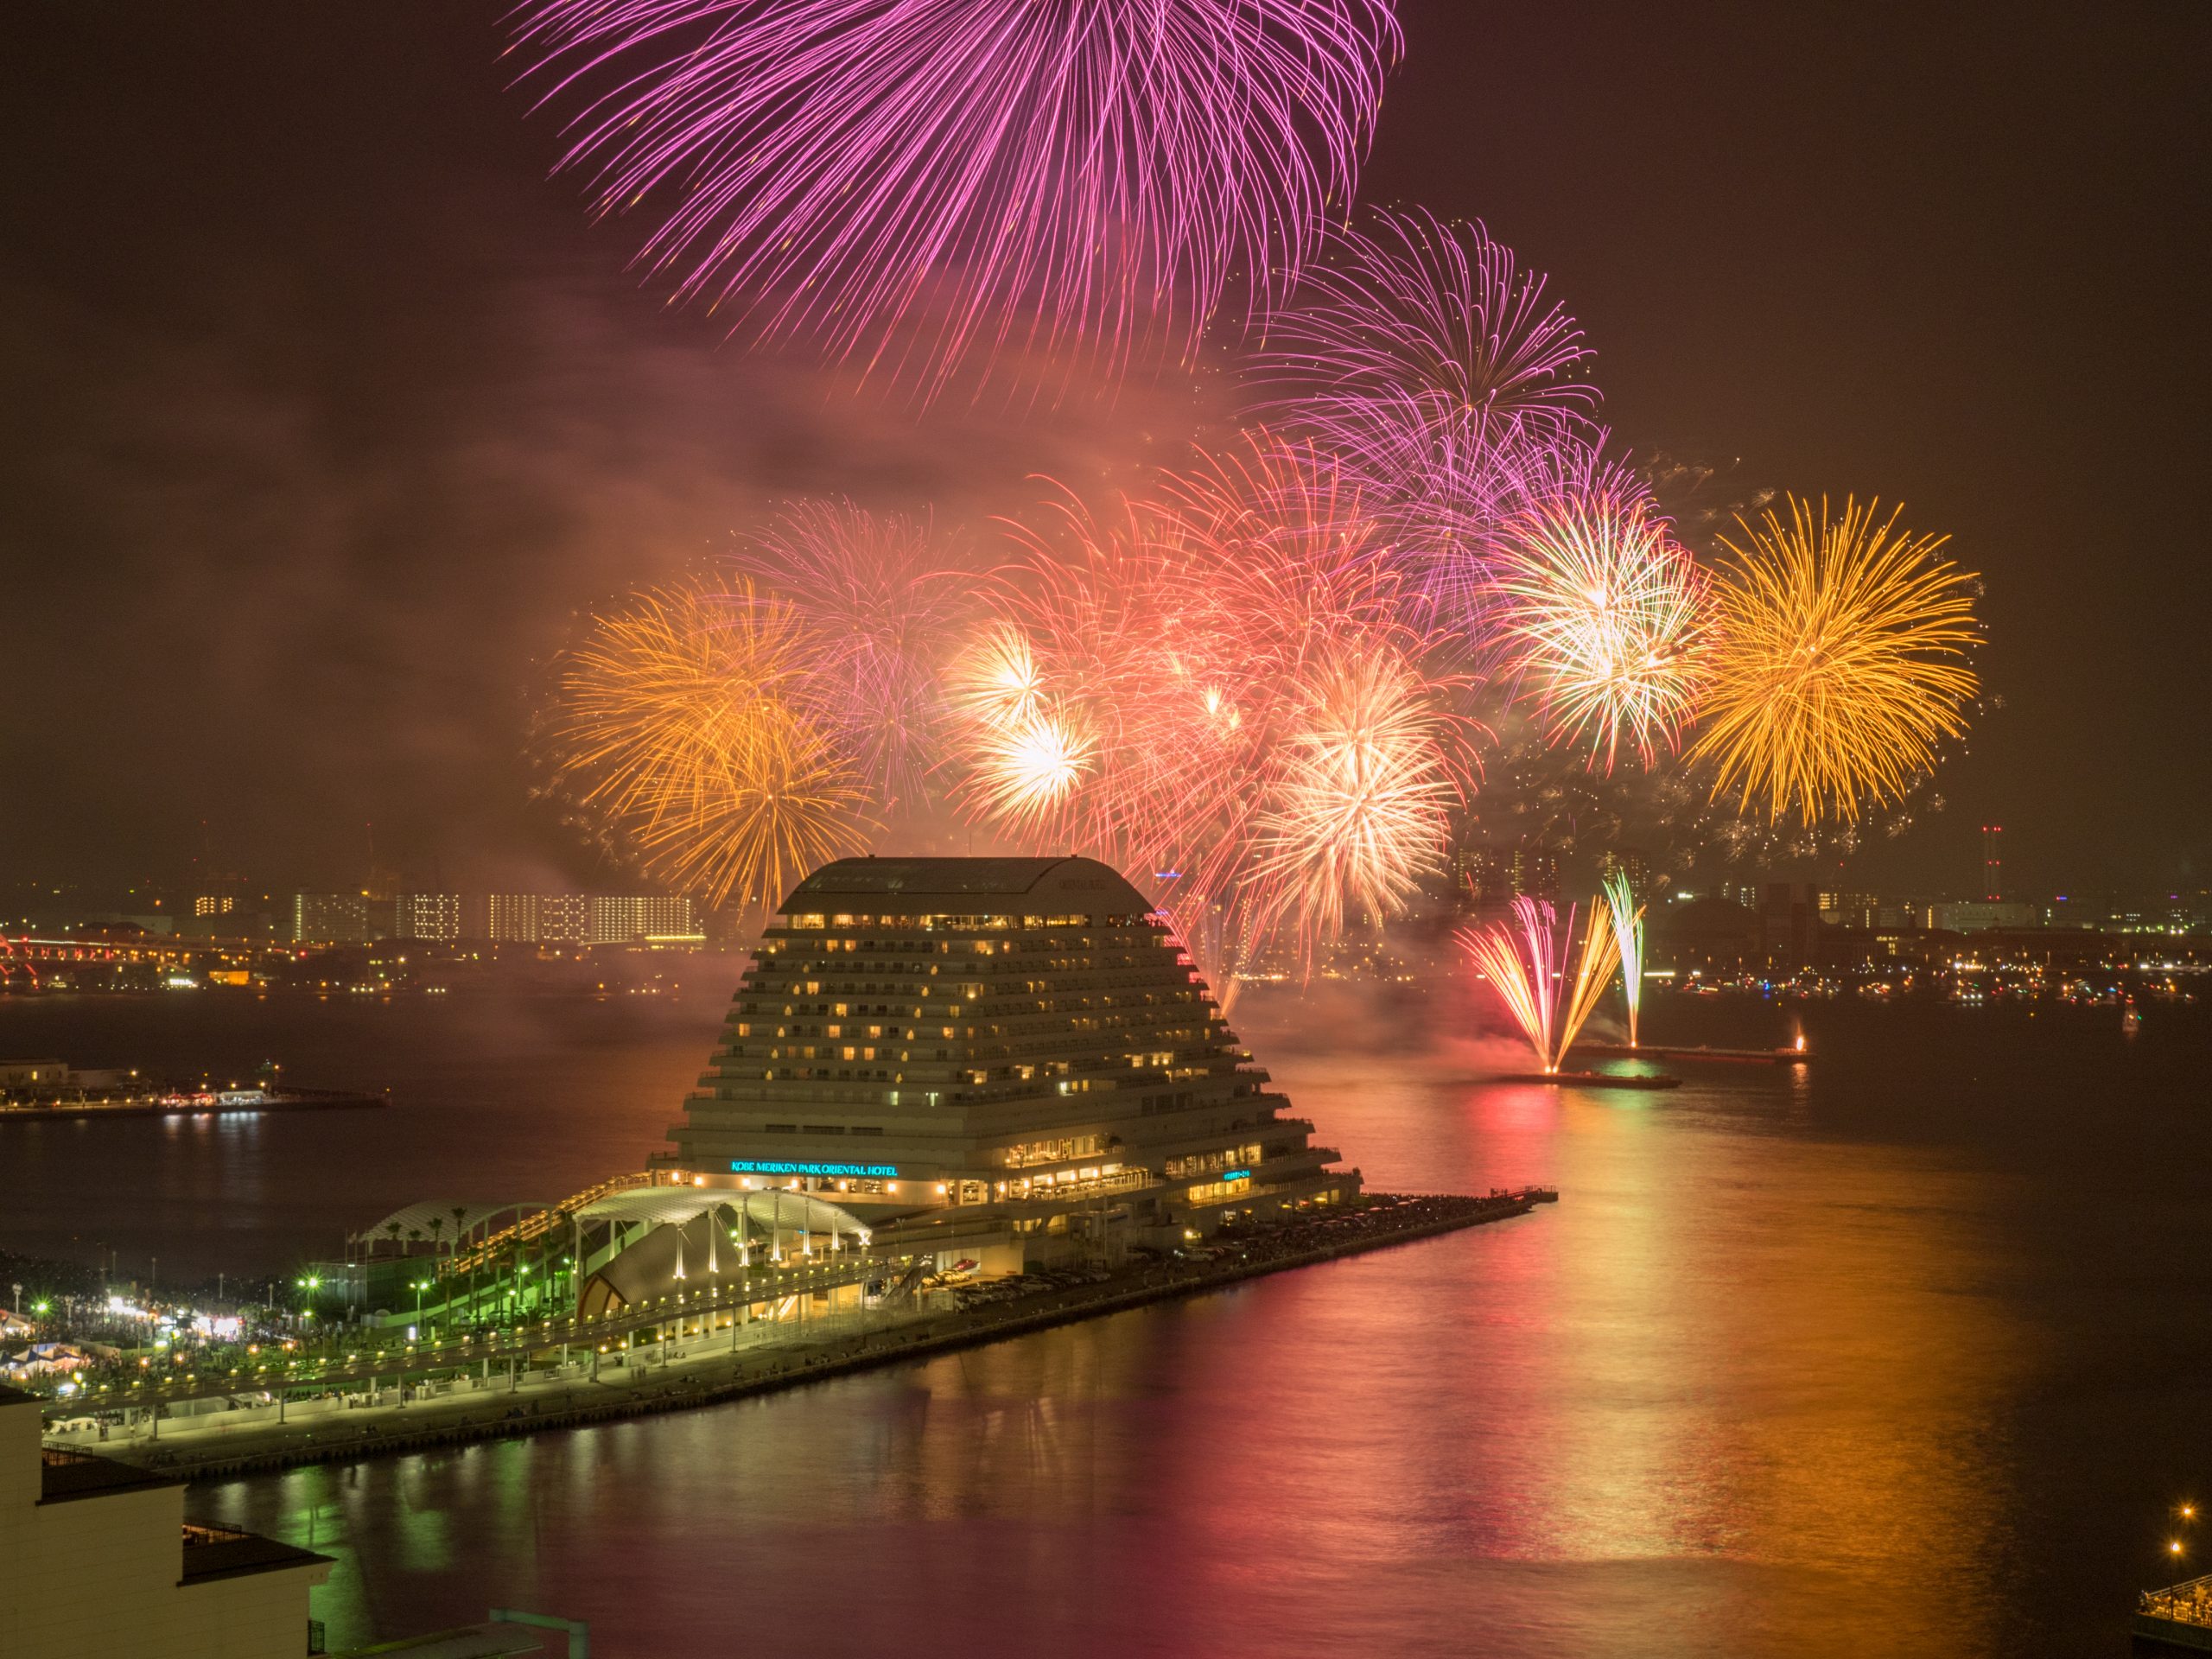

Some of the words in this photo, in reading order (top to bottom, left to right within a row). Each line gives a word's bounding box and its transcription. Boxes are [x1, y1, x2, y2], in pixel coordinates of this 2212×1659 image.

[731, 1161, 755, 1172] KOBE
[756, 1162, 798, 1173] MERIKEN
[798, 1164, 822, 1174] PARK
[821, 1164, 867, 1175] ORIENTAL
[867, 1166, 899, 1176] HOTEL
